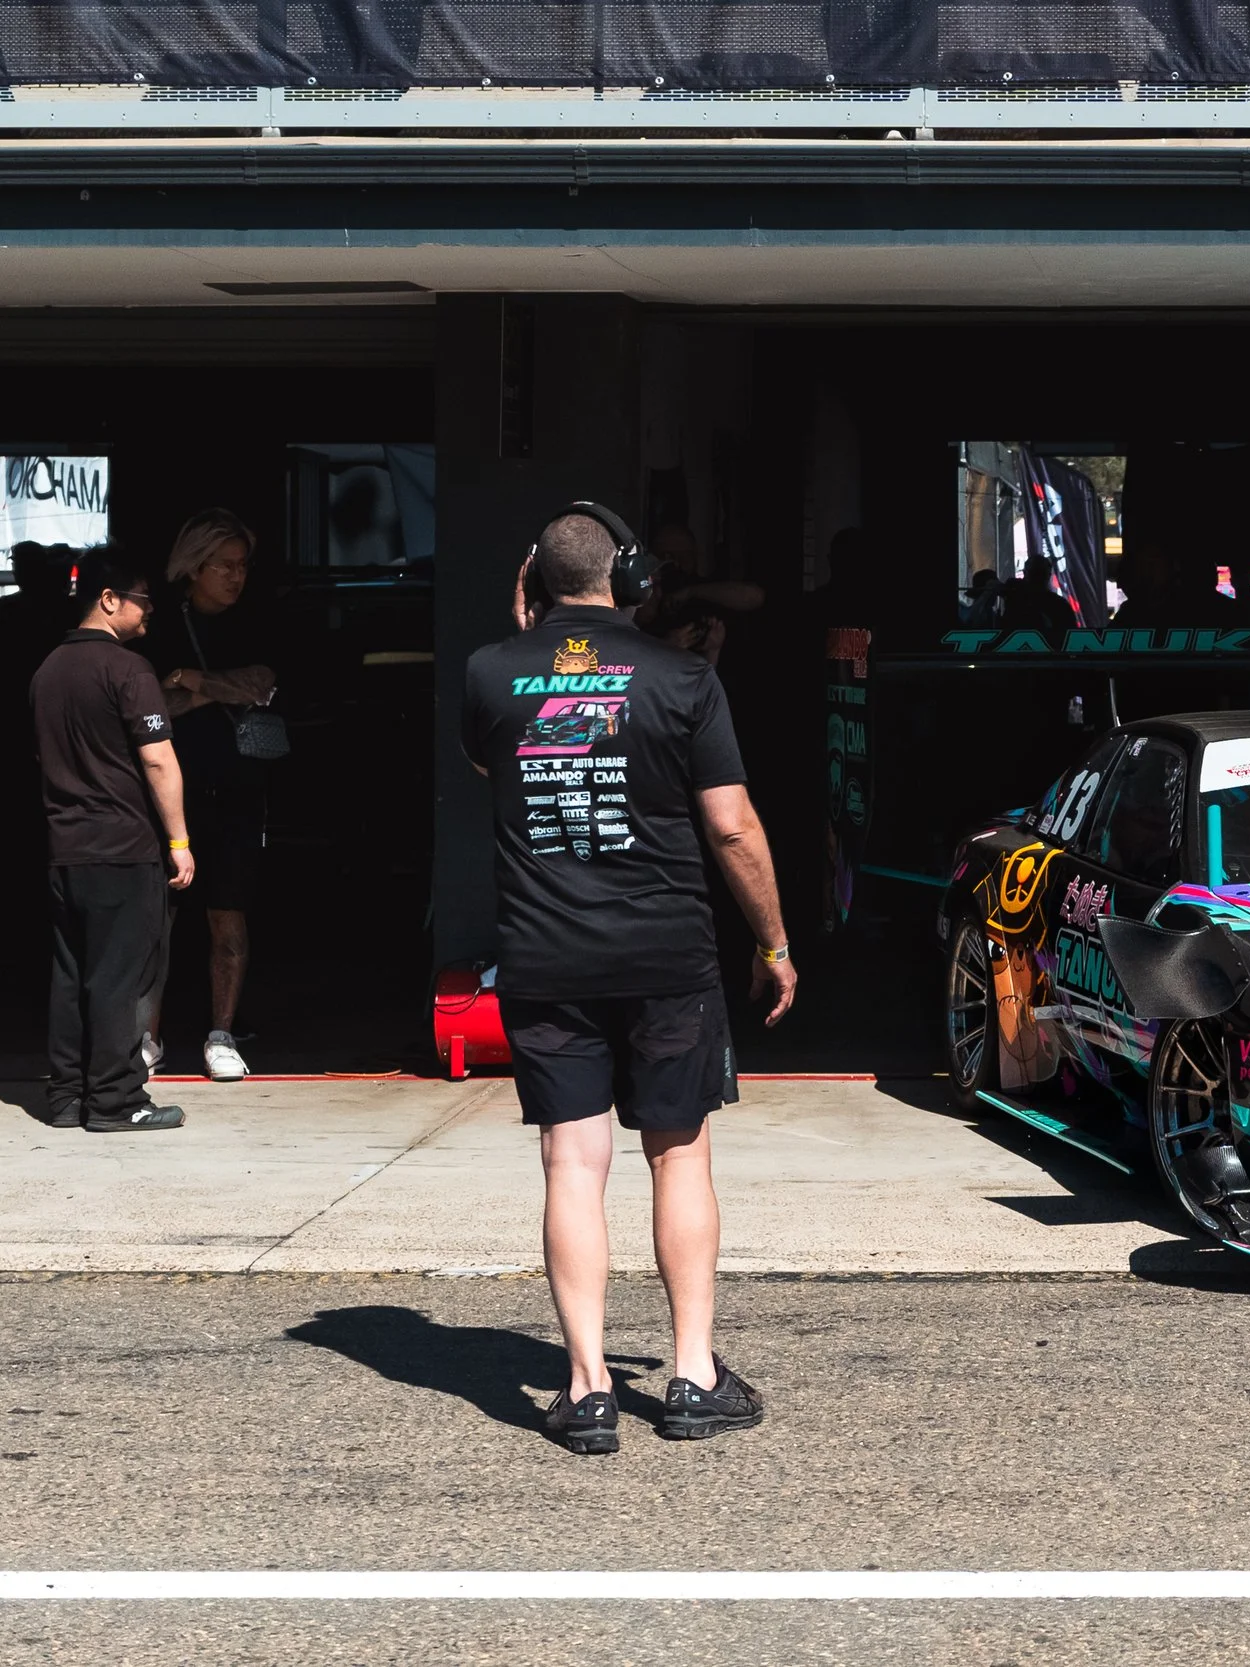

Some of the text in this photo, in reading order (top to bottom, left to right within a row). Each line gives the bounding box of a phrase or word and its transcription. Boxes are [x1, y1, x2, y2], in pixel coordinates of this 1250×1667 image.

[597, 665, 635, 675] CREW
[512, 675, 633, 696] TANUKI
[572, 758, 594, 769] AUTO
[595, 757, 628, 768] GARAGE
[522, 771, 584, 783] AMAANDO
[593, 771, 627, 784] CMA
[558, 792, 591, 806] HKS
[1050, 769, 1100, 841] 13
[1057, 935, 1125, 1004] TANU
